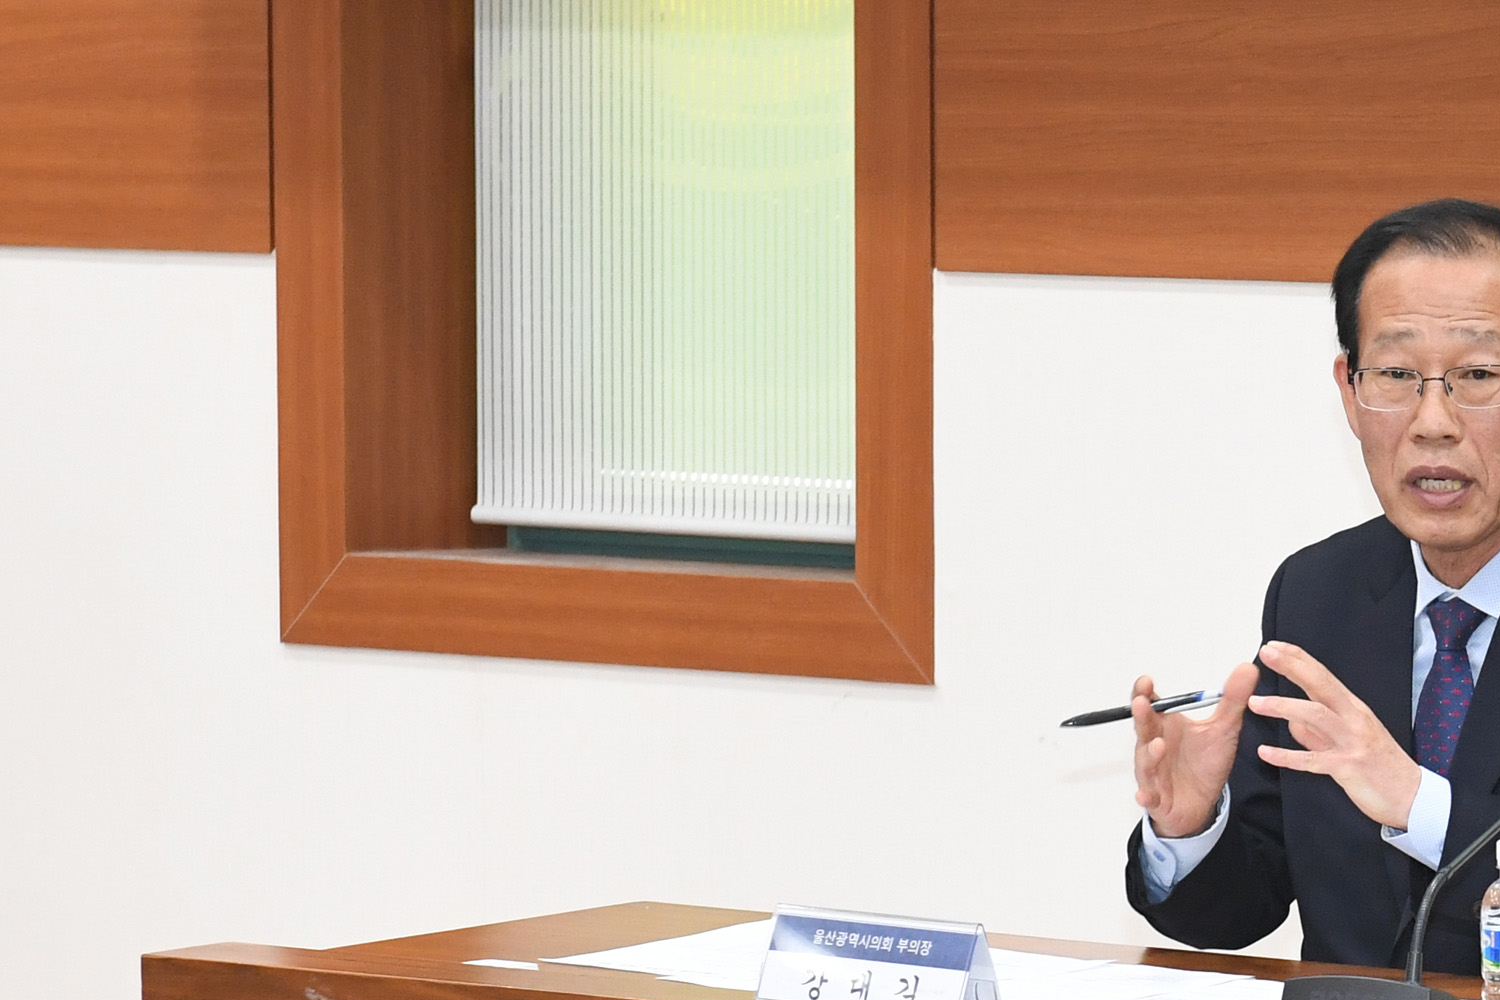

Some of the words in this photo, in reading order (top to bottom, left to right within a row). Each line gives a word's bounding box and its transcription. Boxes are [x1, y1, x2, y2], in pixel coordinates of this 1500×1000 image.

[813, 929, 893, 952] 울산광역시의회
[896, 938, 933, 957] 부의장
[802, 969, 829, 1000] 강
